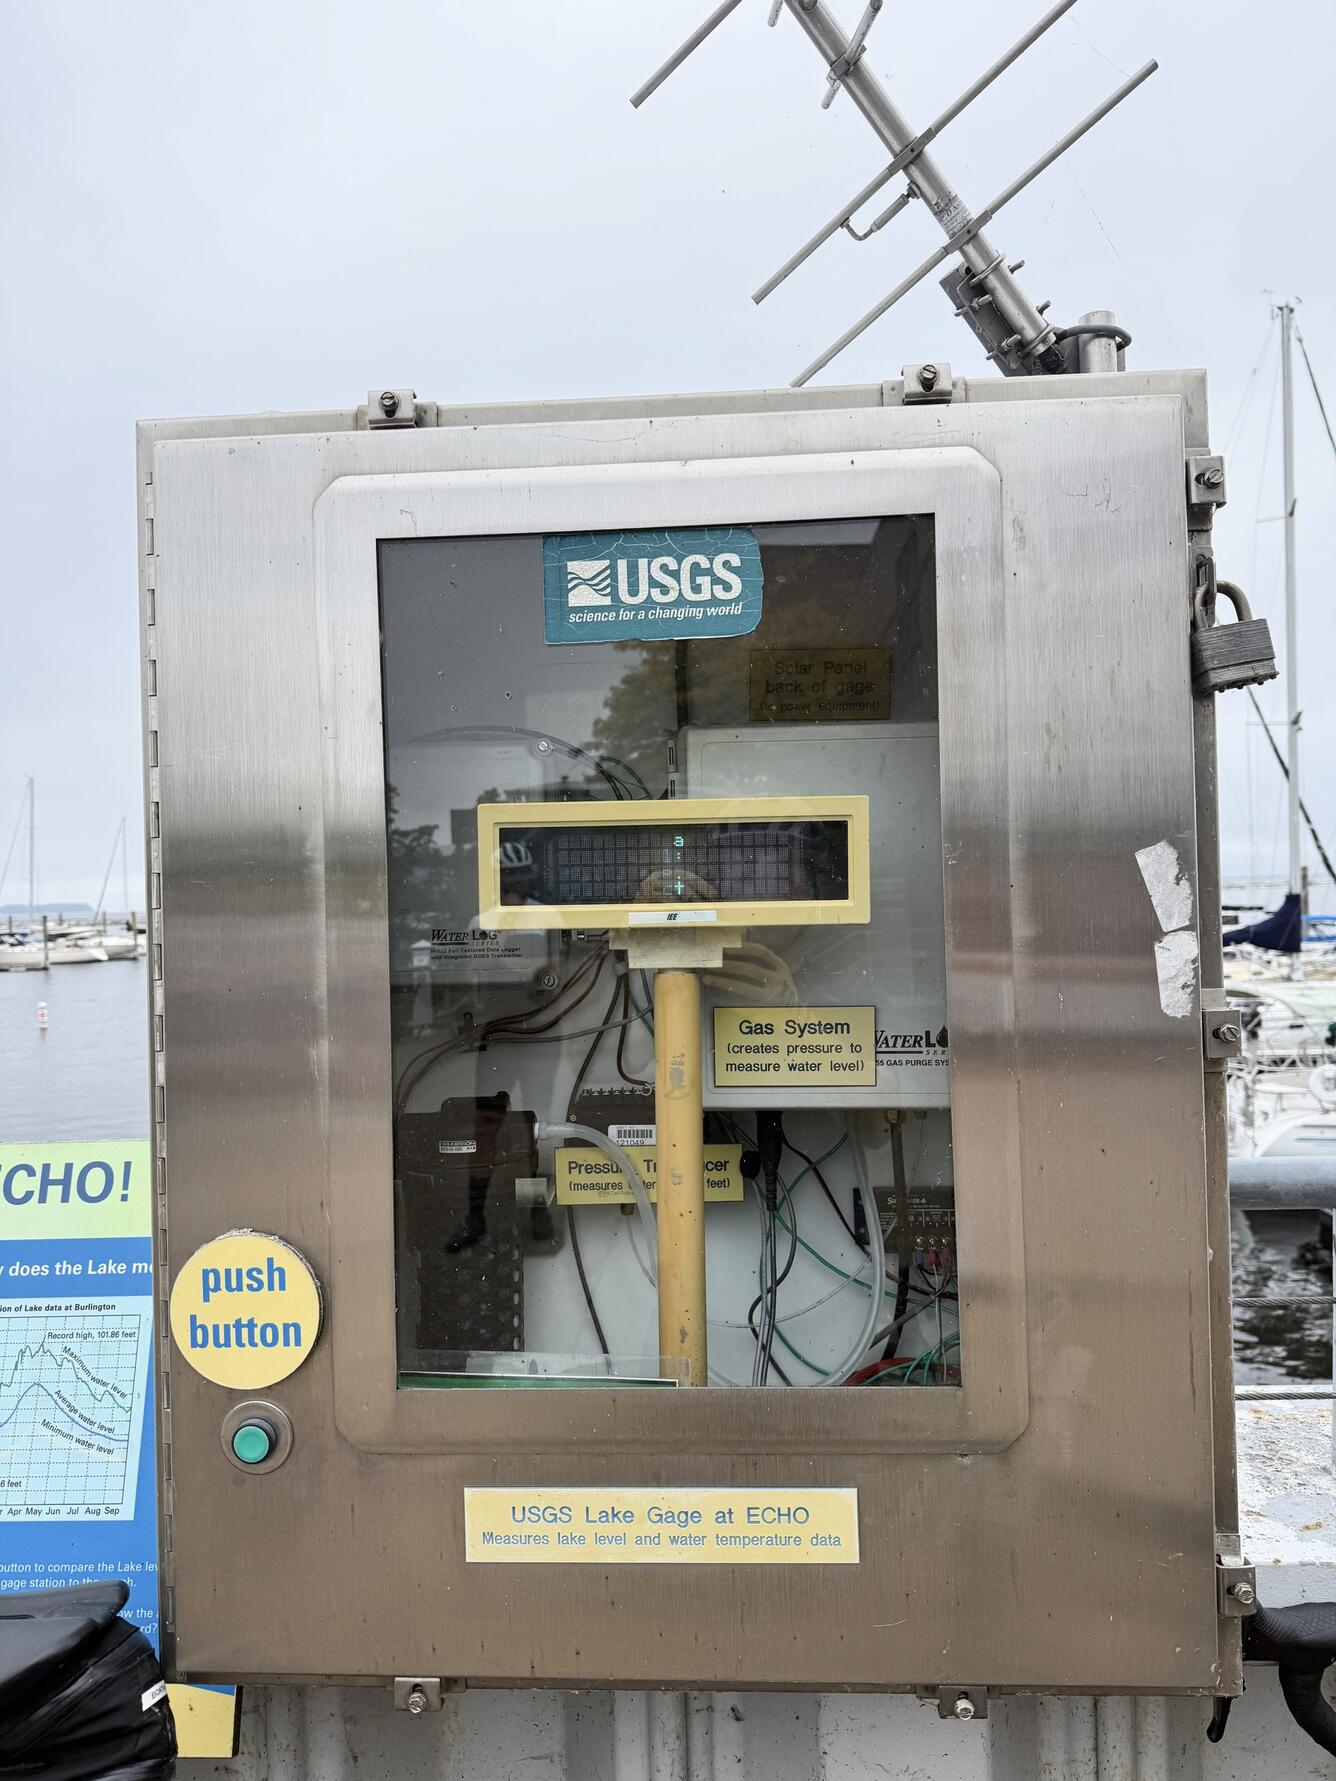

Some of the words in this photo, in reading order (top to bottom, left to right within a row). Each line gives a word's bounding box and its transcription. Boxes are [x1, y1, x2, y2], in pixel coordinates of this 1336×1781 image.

[617, 552, 743, 605] USGS
[569, 609, 616, 623] science
[618, 607, 636, 621] for
[638, 611, 645, 620] a
[648, 605, 703, 620] changing
[707, 603, 742, 616] world
[774, 661, 815, 675] Solar
[823, 661, 868, 675] Panel
[766, 680, 803, 694] back
[811, 680, 828, 693] of
[835, 681, 874, 696] gage
[780, 702, 812, 713] power
[666, 913, 679, 921] IEE
[738, 1019, 775, 1036] Gas
[784, 1018, 851, 1038] System
[727, 1041, 780, 1055] (creates
[786, 1042, 843, 1057] pressure
[849, 1041, 863, 1054] to
[725, 1061, 781, 1073] measure
[789, 1059, 823, 1073] water
[829, 1058, 865, 1073] level)
[886, 1059, 904, 1067] GAS
[905, 1059, 933, 1067] PURGE
[0, 1160, 132, 1206] CHO!
[569, 1180, 623, 1192] (measures
[706, 1177, 730, 1189] feet)
[9, 1261, 49, 1277] does
[55, 1260, 82, 1275] the
[88, 1259, 126, 1275] Lake
[201, 1256, 286, 1303] push
[14, 1304, 23, 1313] of
[24, 1304, 43, 1312] Lake
[44, 1303, 62, 1312] data
[64, 1303, 73, 1312] at
[74, 1303, 116, 1312] Burlington
[47, 1331, 74, 1340] Record
[76, 1331, 95, 1341] high,
[97, 1331, 120, 1340] 101.86
[121, 1331, 136, 1339] feet
[189, 1314, 302, 1349] button
[62, 1345, 92, 1378] Maximum
[90, 1374, 110, 1389] water
[110, 1382, 128, 1400] level
[54, 1389, 78, 1415] Average
[77, 1410, 97, 1429] water
[98, 1421, 115, 1435] level
[40, 1418, 74, 1442] Minimum
[74, 1435, 96, 1449] water
[96, 1443, 115, 1456] level
[7, 1478, 22, 1488] feet
[7, 1507, 22, 1517] Apr
[25, 1507, 43, 1517] May
[45, 1507, 61, 1516] Jun
[66, 1506, 80, 1516] Jul
[84, 1506, 101, 1517] Aug
[104, 1506, 120, 1516] Sep
[511, 1505, 572, 1524] USGS
[585, 1505, 635, 1524] Lake
[646, 1505, 702, 1528] Gage
[714, 1506, 735, 1524] at
[746, 1505, 811, 1525] ECHO
[481, 1530, 550, 1546] Measures
[557, 1531, 586, 1546] lake
[594, 1531, 627, 1546] level
[634, 1531, 661, 1546] and
[668, 1532, 707, 1546] water
[715, 1531, 802, 1549] temperature
[810, 1531, 842, 1547] data
[34, 1562, 45, 1573] to
[47, 1563, 95, 1576] compare
[98, 1562, 115, 1573] the
[117, 1561, 142, 1573] Lake
[0, 1580, 27, 1590] gage
[29, 1578, 66, 1588] station
[68, 1577, 80, 1587] to
[136, 1607, 154, 1618] the
